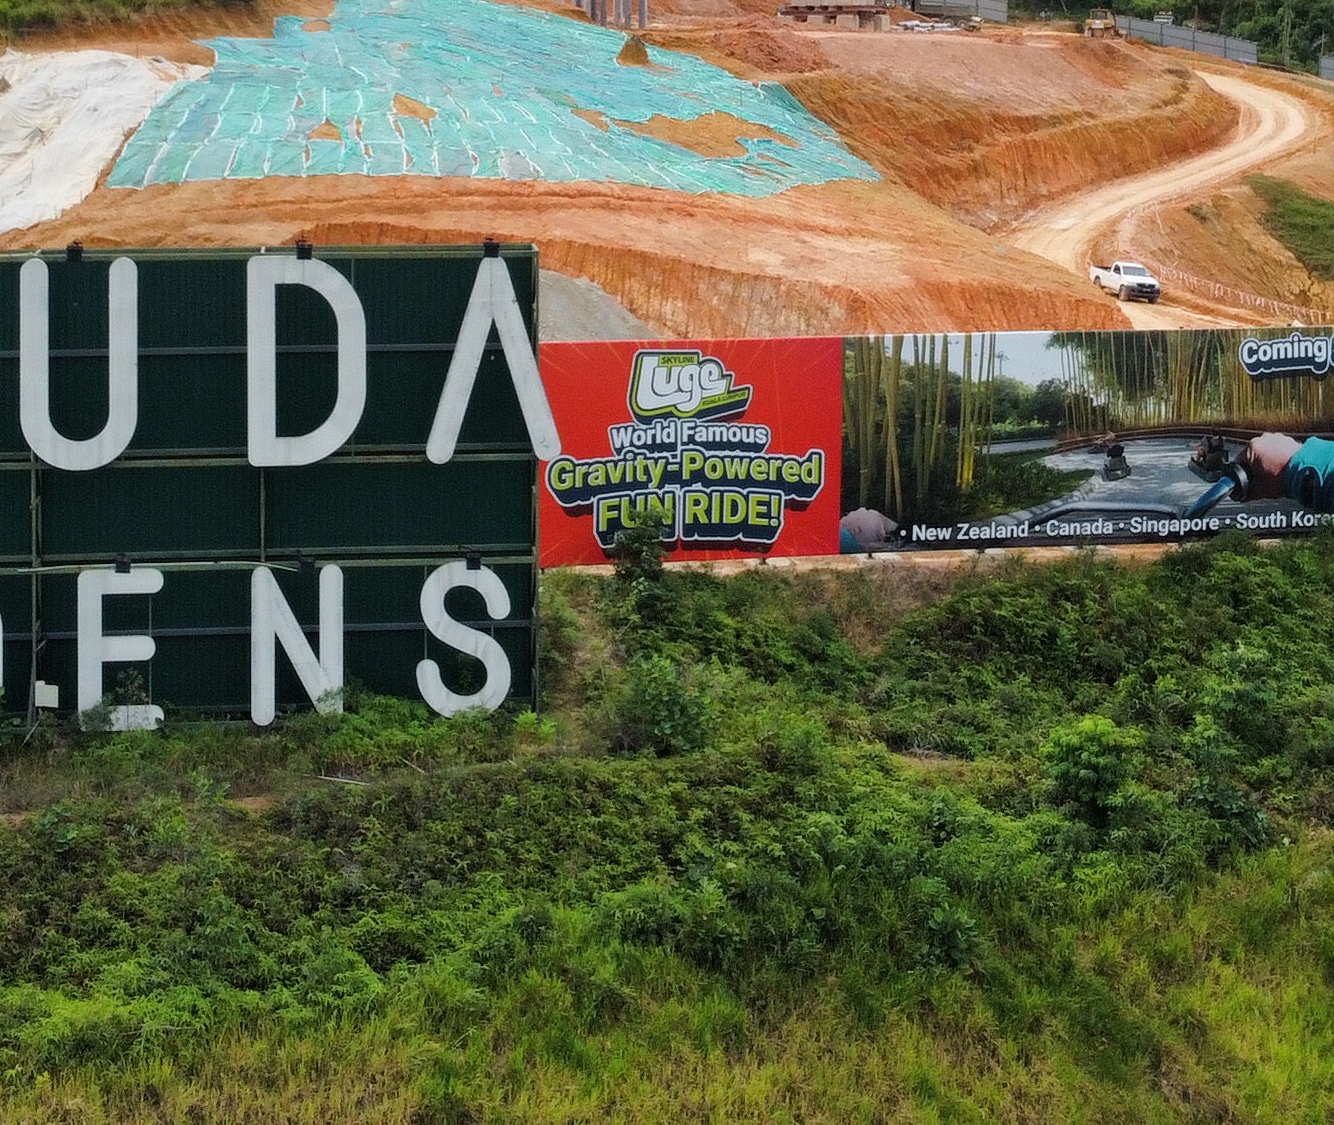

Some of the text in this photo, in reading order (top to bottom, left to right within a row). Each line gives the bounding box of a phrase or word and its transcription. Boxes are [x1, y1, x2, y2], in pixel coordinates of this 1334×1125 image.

[660, 356, 695, 365] SKYLINE
[1241, 335, 1328, 364] Coming
[636, 356, 728, 412] Luge
[611, 420, 768, 449] World Famous
[549, 451, 820, 491] Gravity-Powered
[598, 492, 780, 533] FUN RIDE!
[911, 524, 953, 542] New
[957, 521, 1029, 541] Zealand
[1046, 517, 1113, 537] Canada
[1129, 516, 1220, 537] Singapore
[1235, 510, 1287, 530] South
